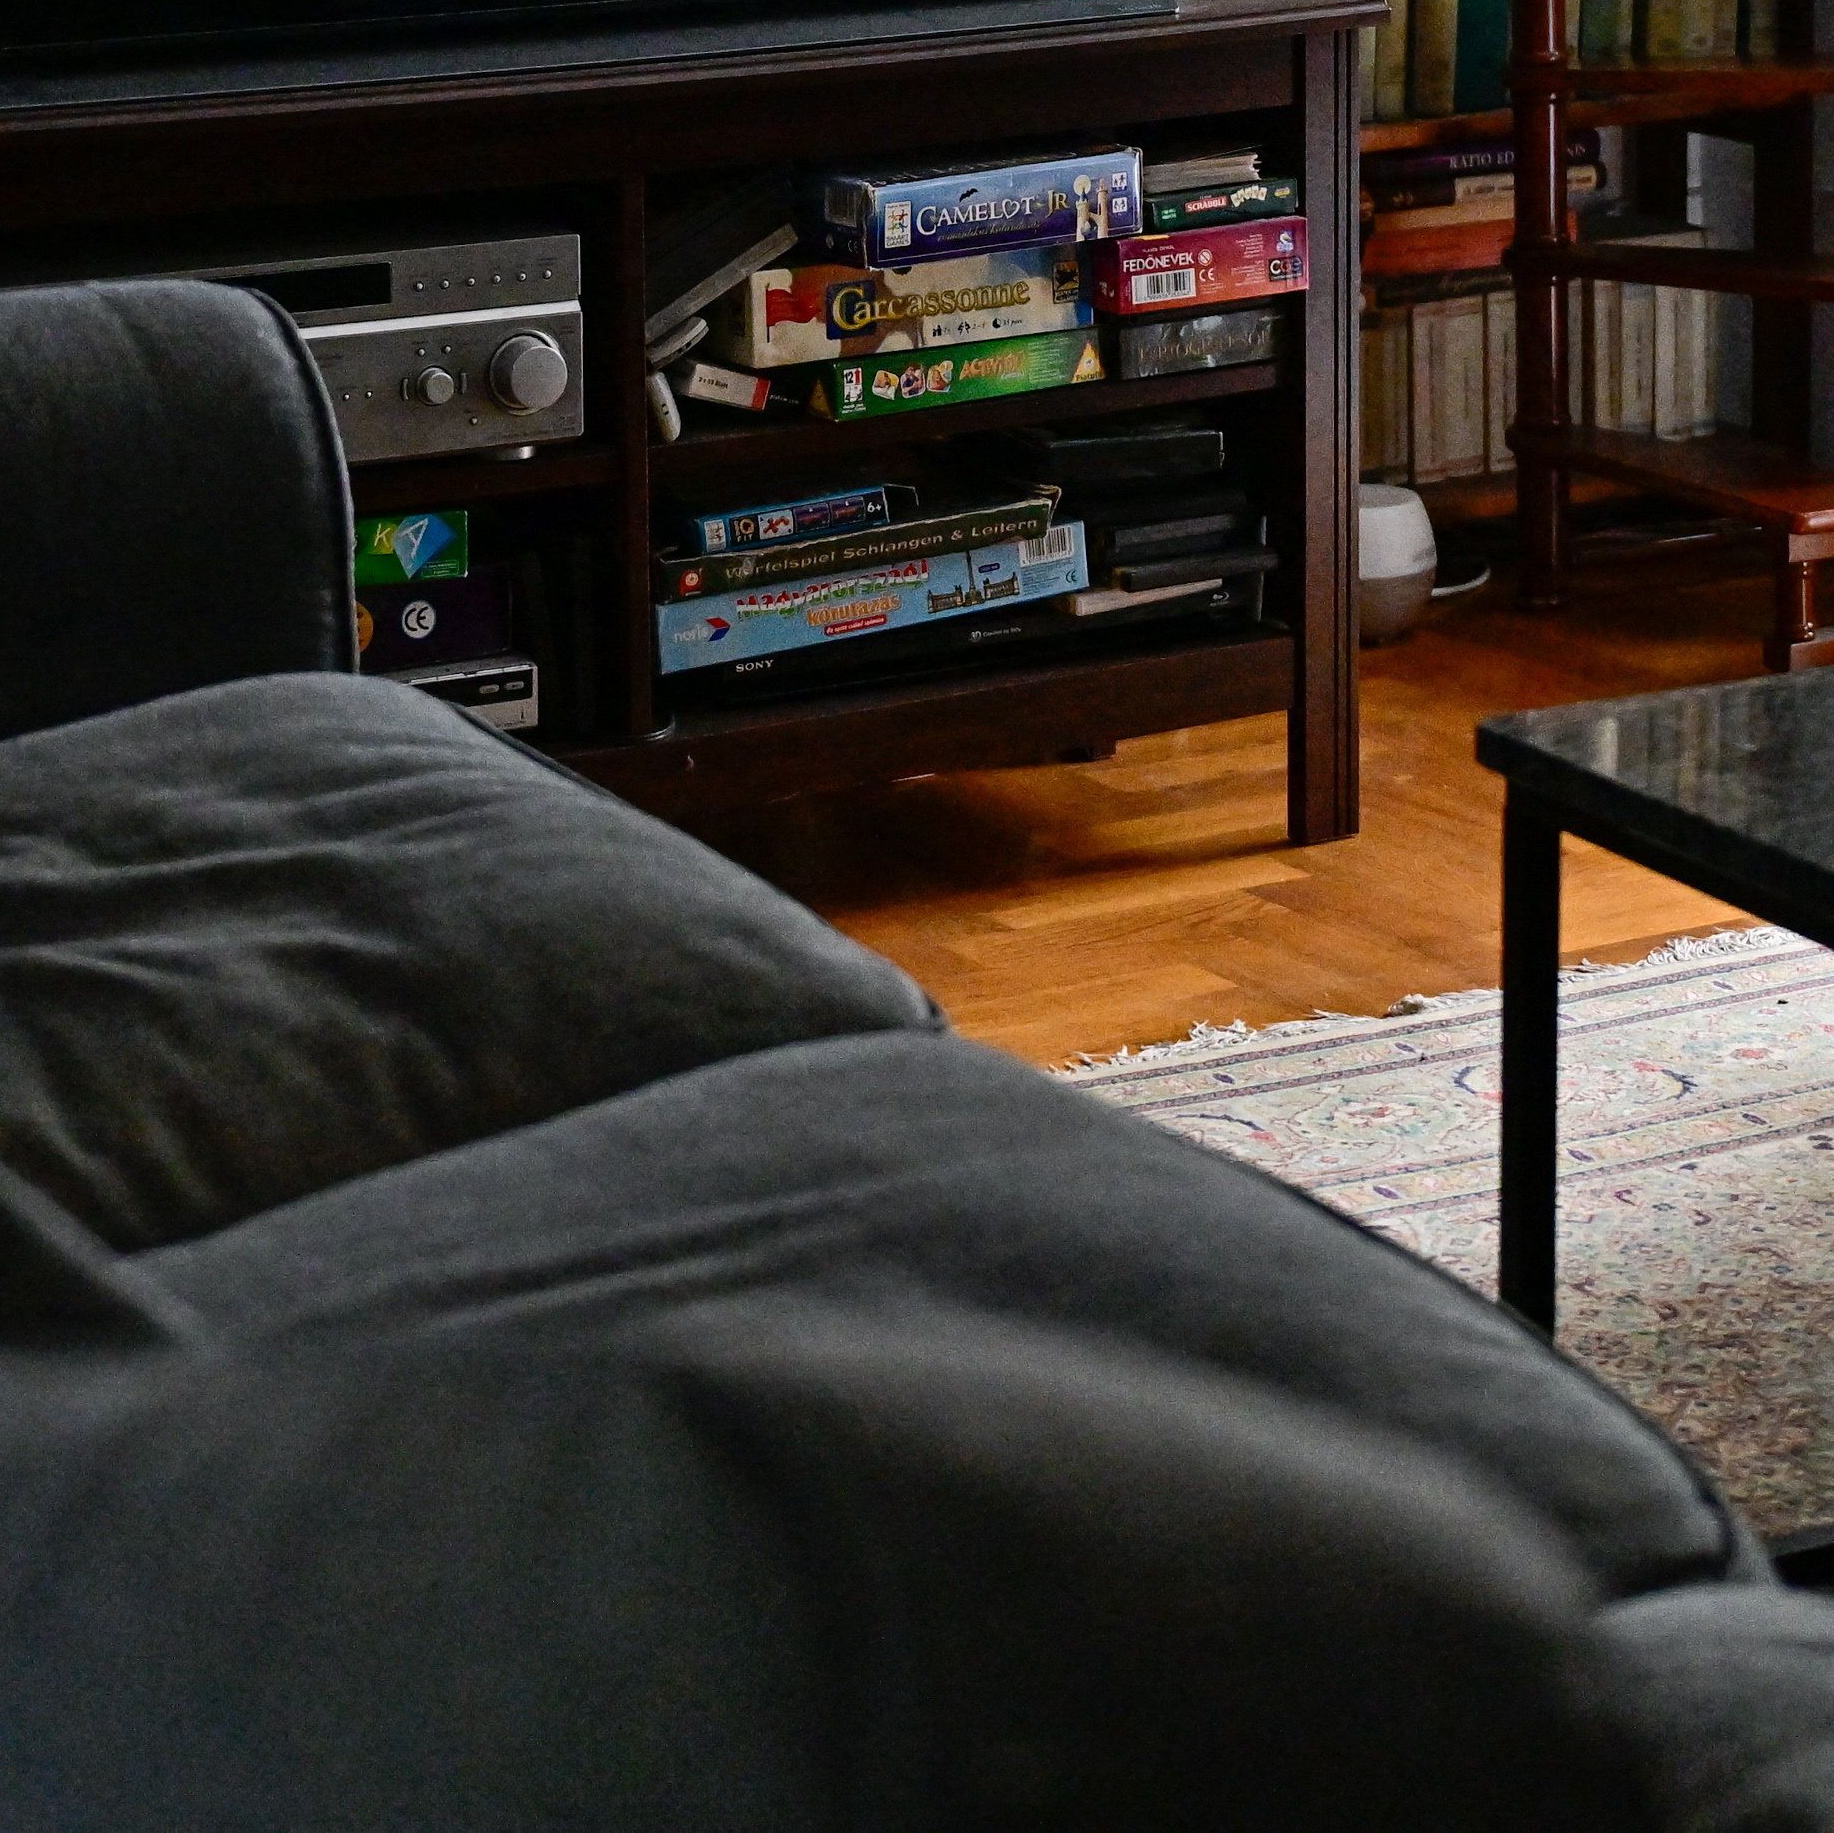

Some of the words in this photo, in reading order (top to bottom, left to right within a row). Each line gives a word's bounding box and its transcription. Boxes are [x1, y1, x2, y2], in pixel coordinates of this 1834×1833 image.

[1449, 152, 1492, 170] RATIO
[1186, 197, 1227, 212] SCRABBLE
[1123, 253, 1195, 273] FEDŐNEVEK
[830, 277, 1030, 332] Carcassonne
[866, 501, 883, 514] 6+
[734, 519, 757, 535] IQ
[736, 534, 753, 543] FIT
[843, 533, 944, 559] Schlangen
[950, 529, 963, 542] &
[971, 518, 1038, 537] Leitern
[736, 559, 929, 622] Magyarországi
[807, 593, 901, 627] körutazás
[674, 619, 710, 643] noris
[736, 659, 774, 674] SONY
